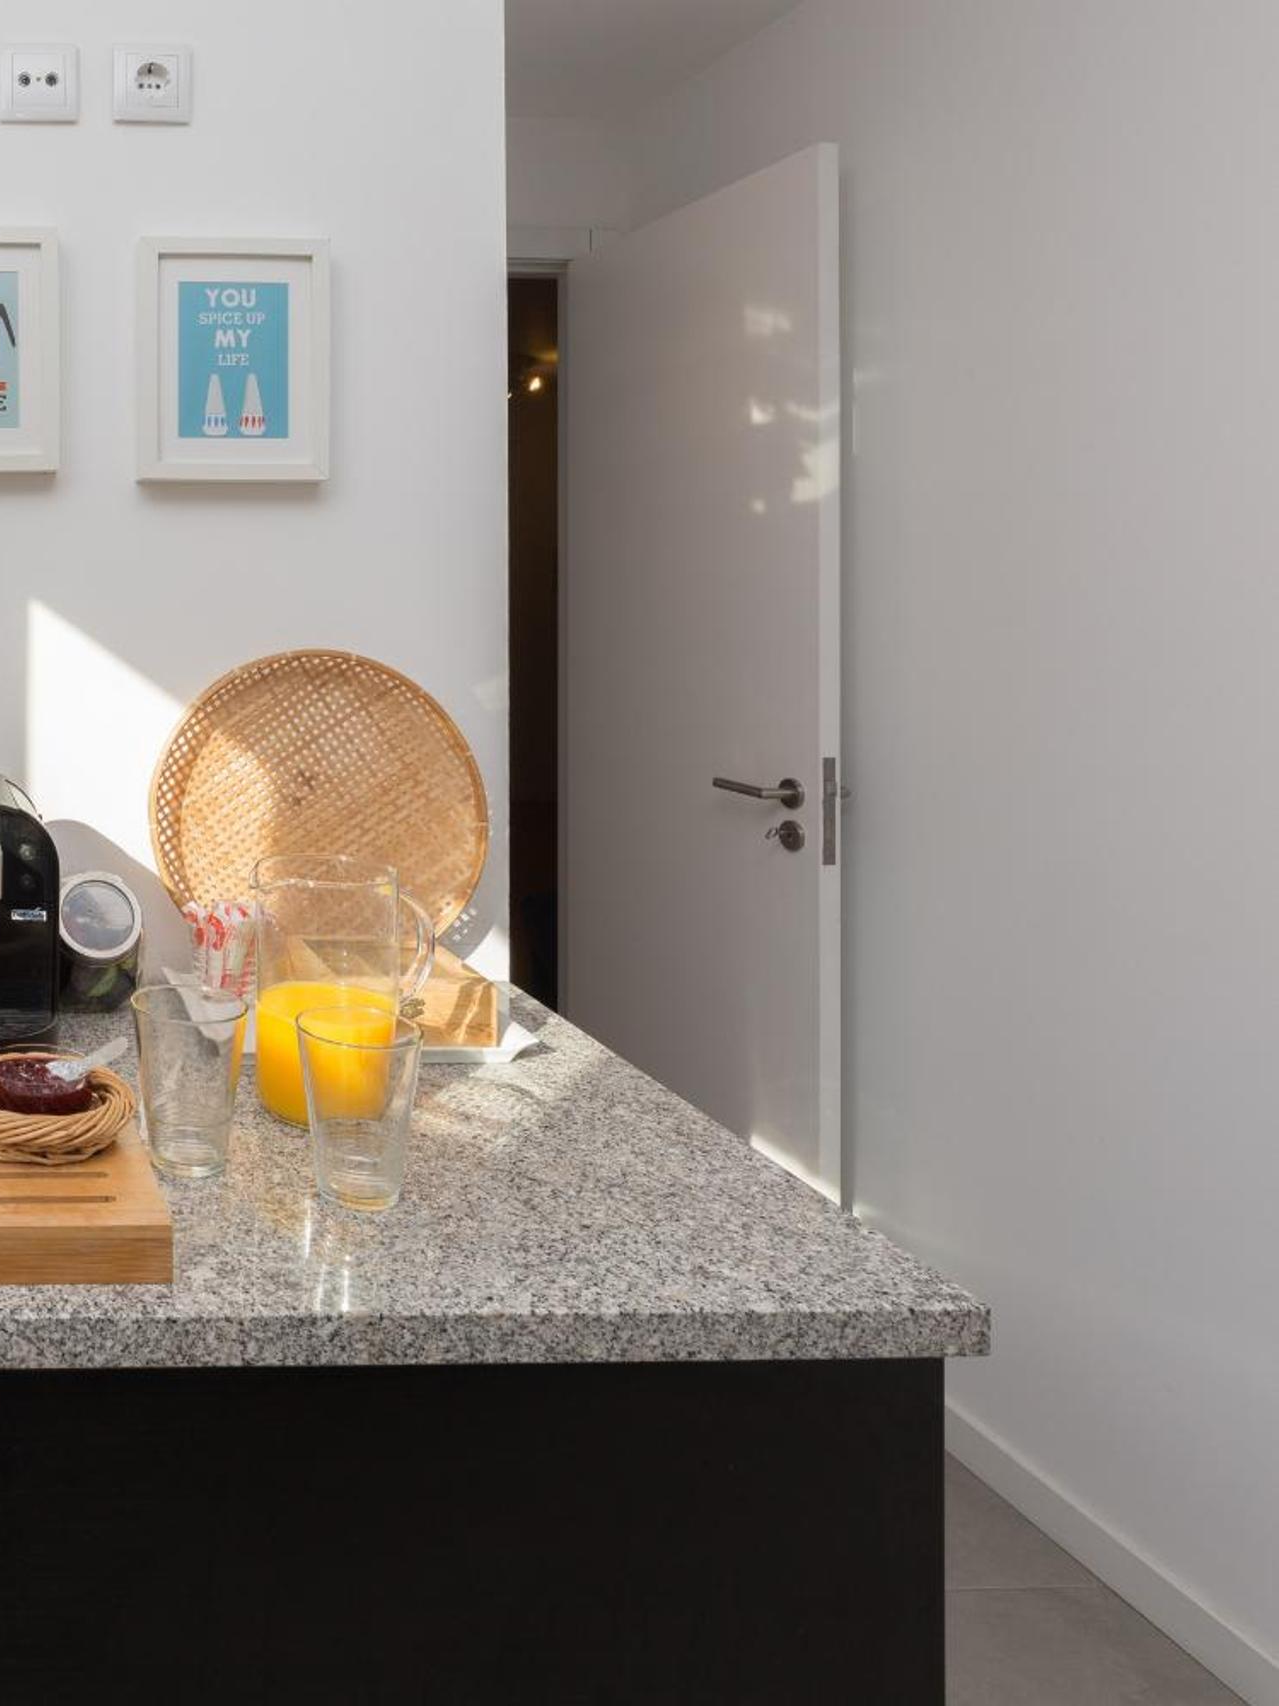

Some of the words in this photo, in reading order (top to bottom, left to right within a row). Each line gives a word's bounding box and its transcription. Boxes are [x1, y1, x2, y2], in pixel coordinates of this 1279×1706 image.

[205, 288, 257, 308] YOU
[198, 312, 243, 325] SPICE
[246, 312, 266, 325] UP
[214, 329, 251, 348] MY
[218, 353, 250, 367] LIFE
